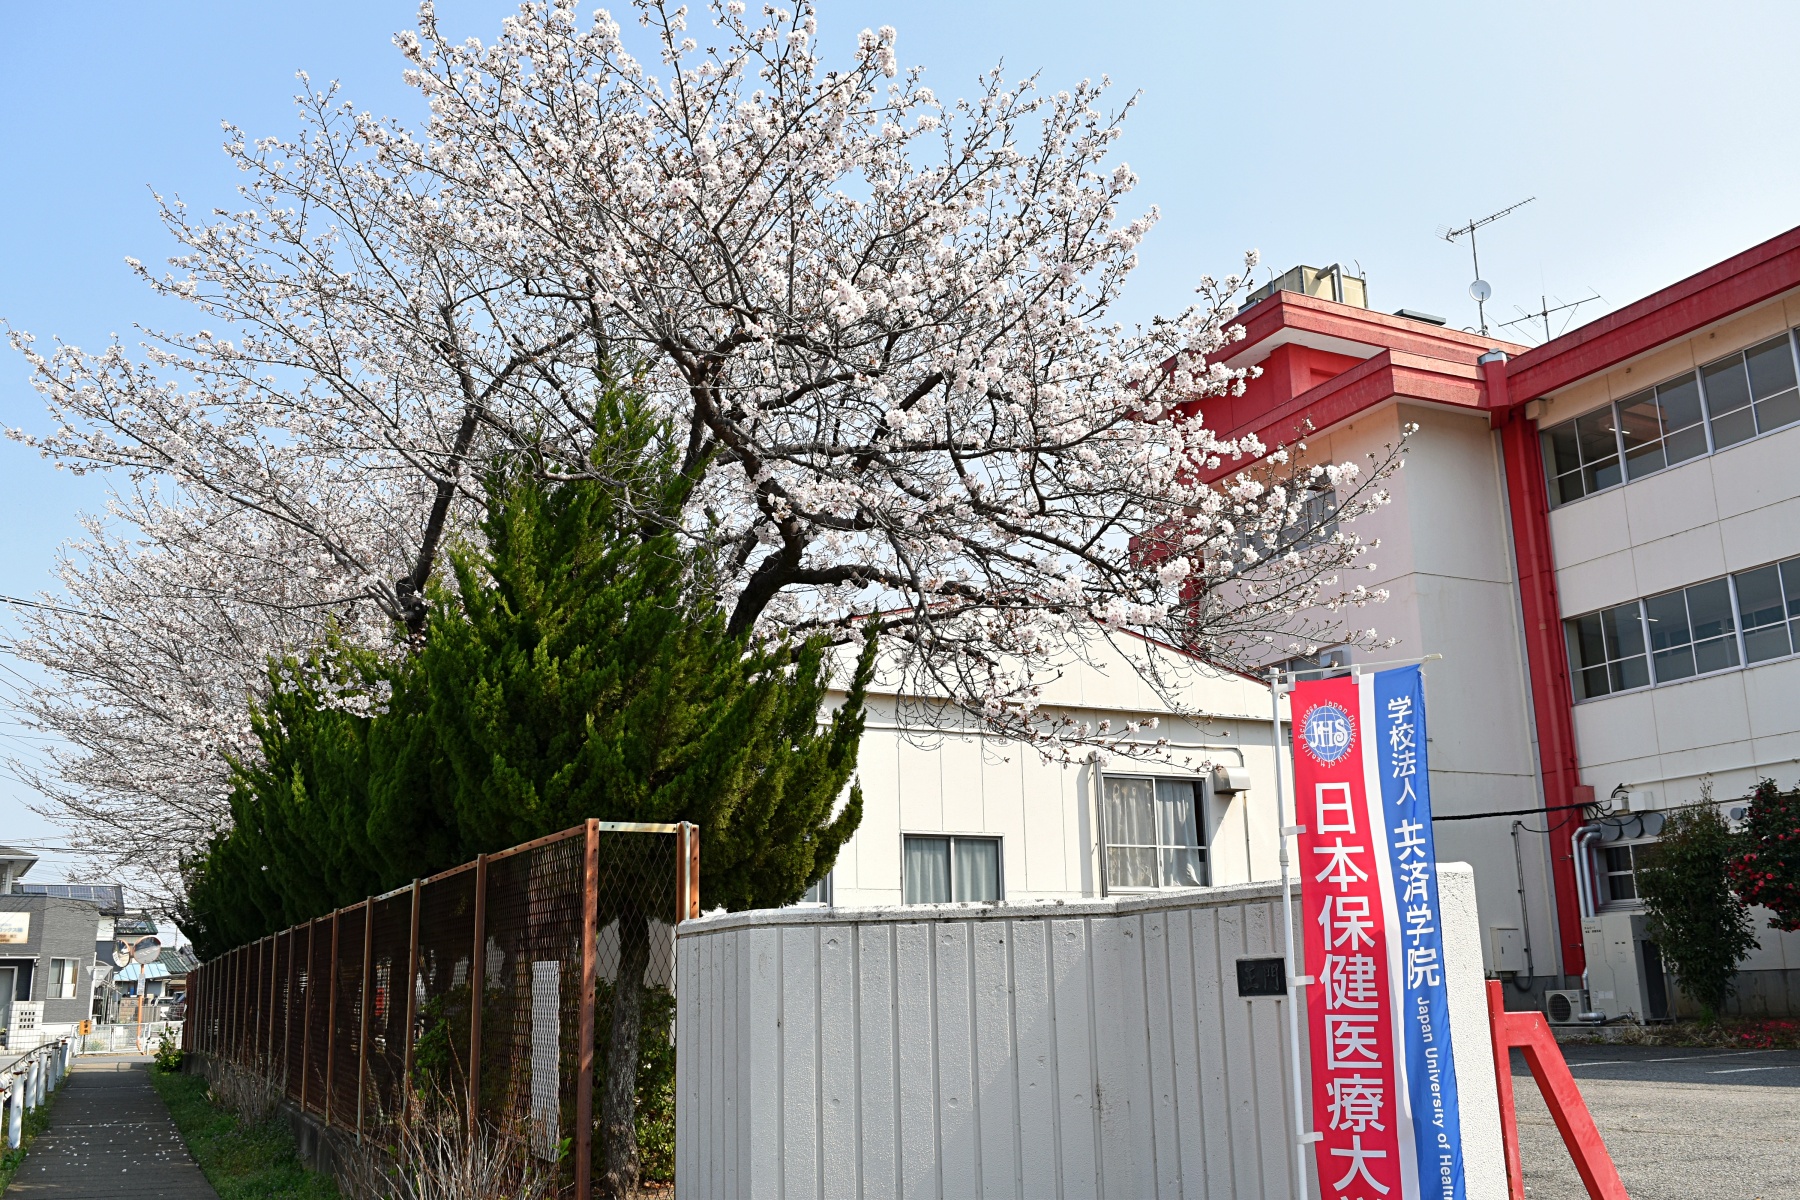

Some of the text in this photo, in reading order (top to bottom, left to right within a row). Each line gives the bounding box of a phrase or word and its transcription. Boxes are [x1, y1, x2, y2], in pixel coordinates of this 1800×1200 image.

[1387, 695, 1440, 990] 学校法人 共済学院
[1313, 781, 1391, 1200] 日本保健医療大
[1417, 996, 1433, 1043] Japan
[1425, 1047, 1445, 1129] University
[1437, 1133, 1451, 1150] of
